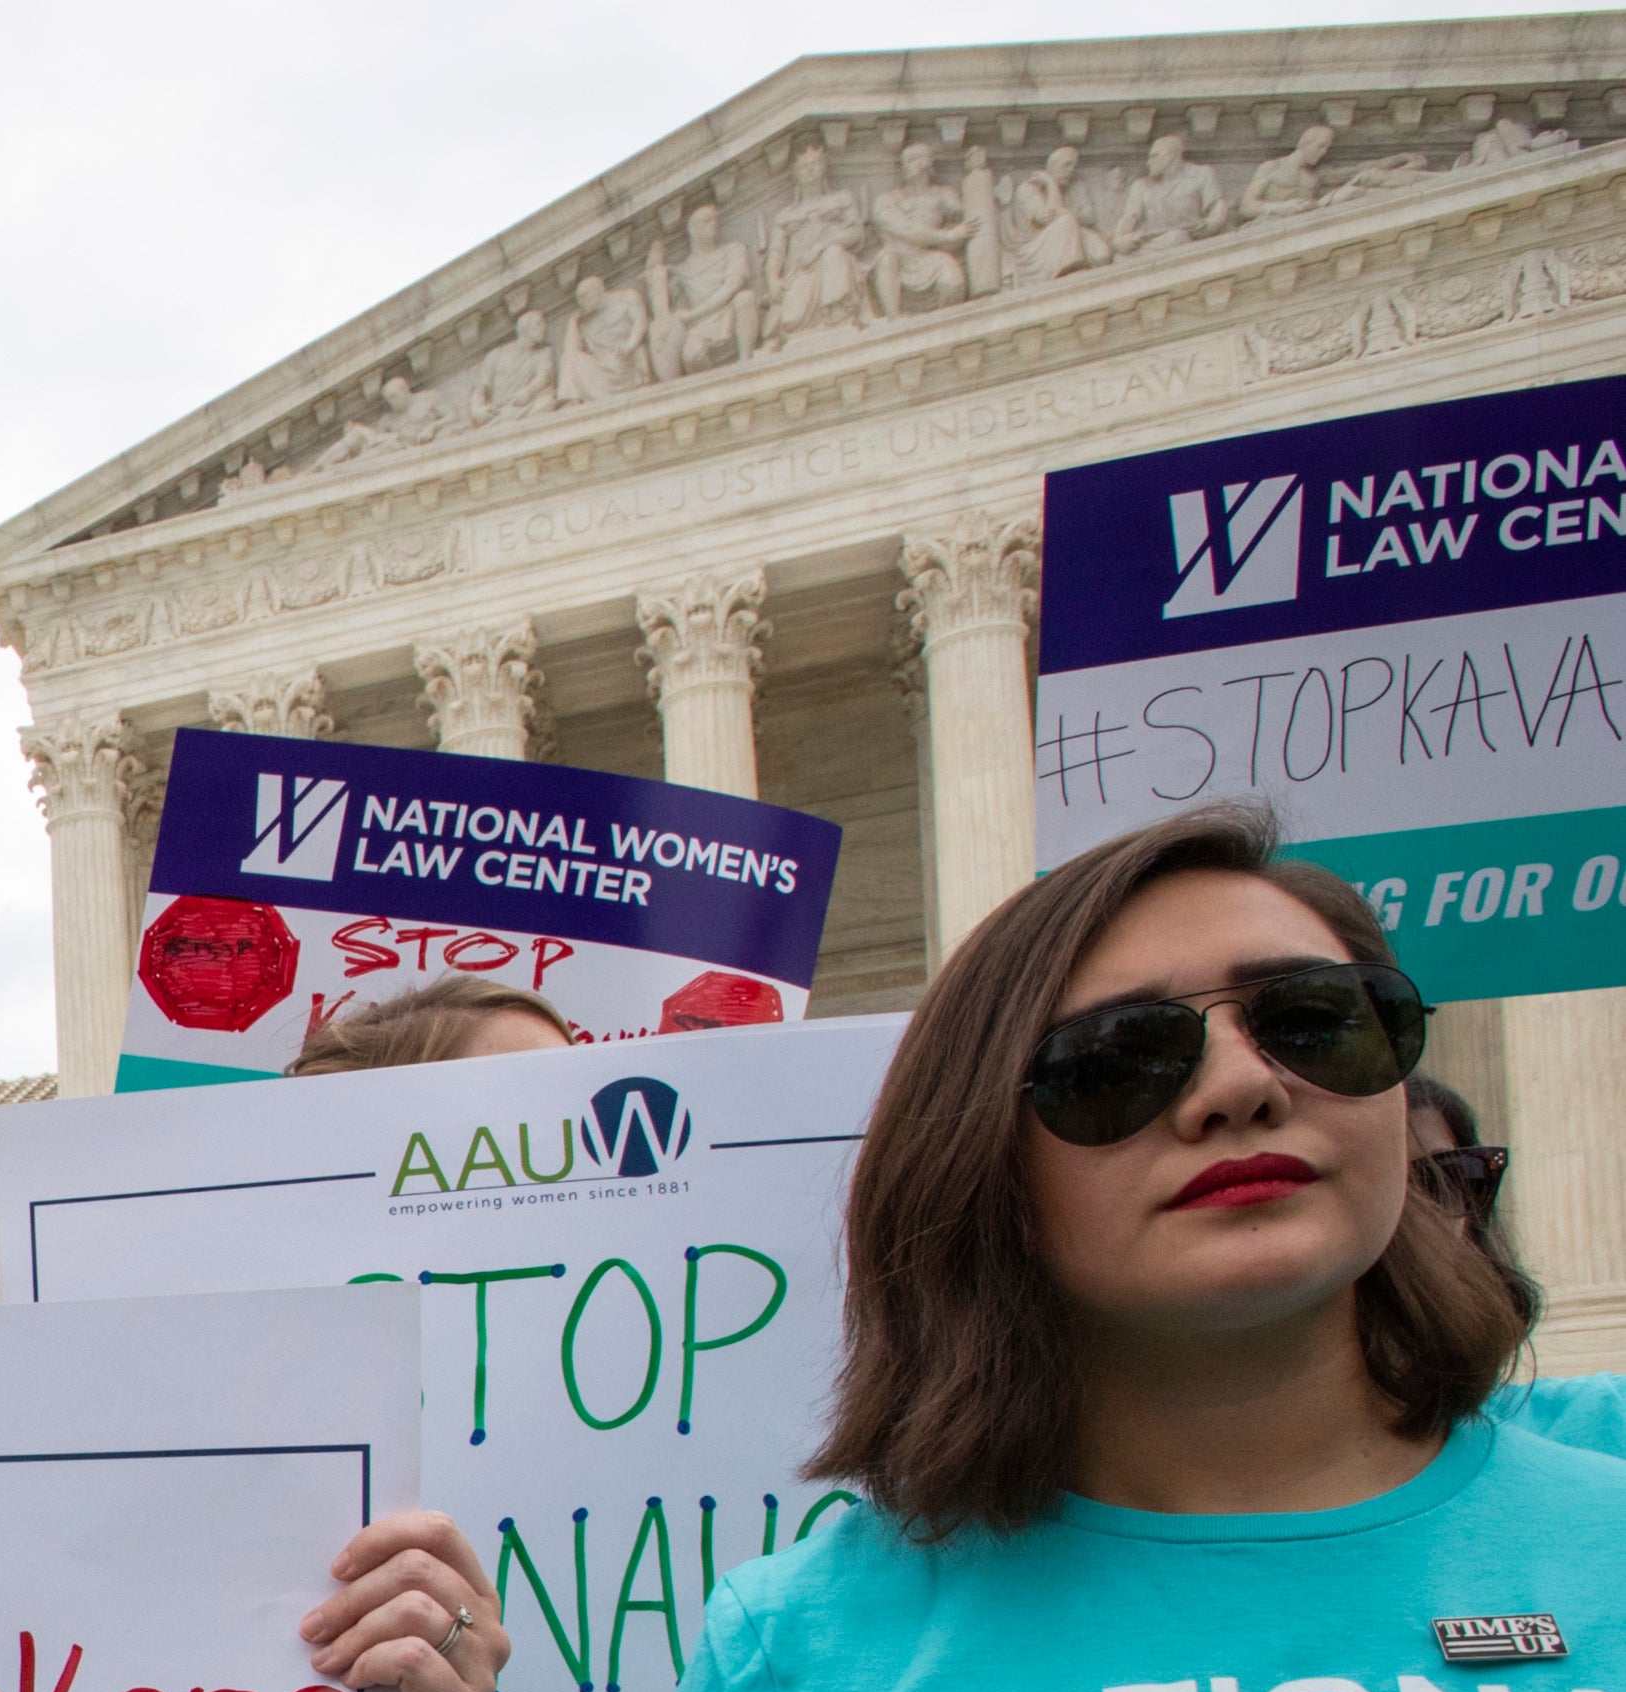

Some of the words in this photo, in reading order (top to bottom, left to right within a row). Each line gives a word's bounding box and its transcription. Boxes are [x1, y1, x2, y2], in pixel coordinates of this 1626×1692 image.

[498, 496, 656, 551] EQUAL
[666, 437, 861, 512] JUSTICE
[888, 390, 1075, 457] UNDER
[1089, 353, 1197, 410] LAW
[1325, 513, 1479, 578] LAW
[1037, 634, 1624, 806] #STOPKAVA
[354, 837, 462, 882] LAW
[474, 850, 653, 906] CENTER
[361, 795, 597, 855] NATIONAL
[610, 823, 798, 895] WOMEN'S
[1424, 862, 1554, 927] FOR
[1572, 854, 1626, 912] O
[331, 916, 575, 991] STOP
[391, 1077, 691, 1196] AAUW
[389, 1197, 502, 1216] empowering
[512, 1189, 578, 1205] women
[589, 1184, 638, 1200] since
[647, 1181, 690, 1196] 1881
[1437, 1615, 1556, 1638] TIME'S
[1513, 1634, 1560, 1653] UP
